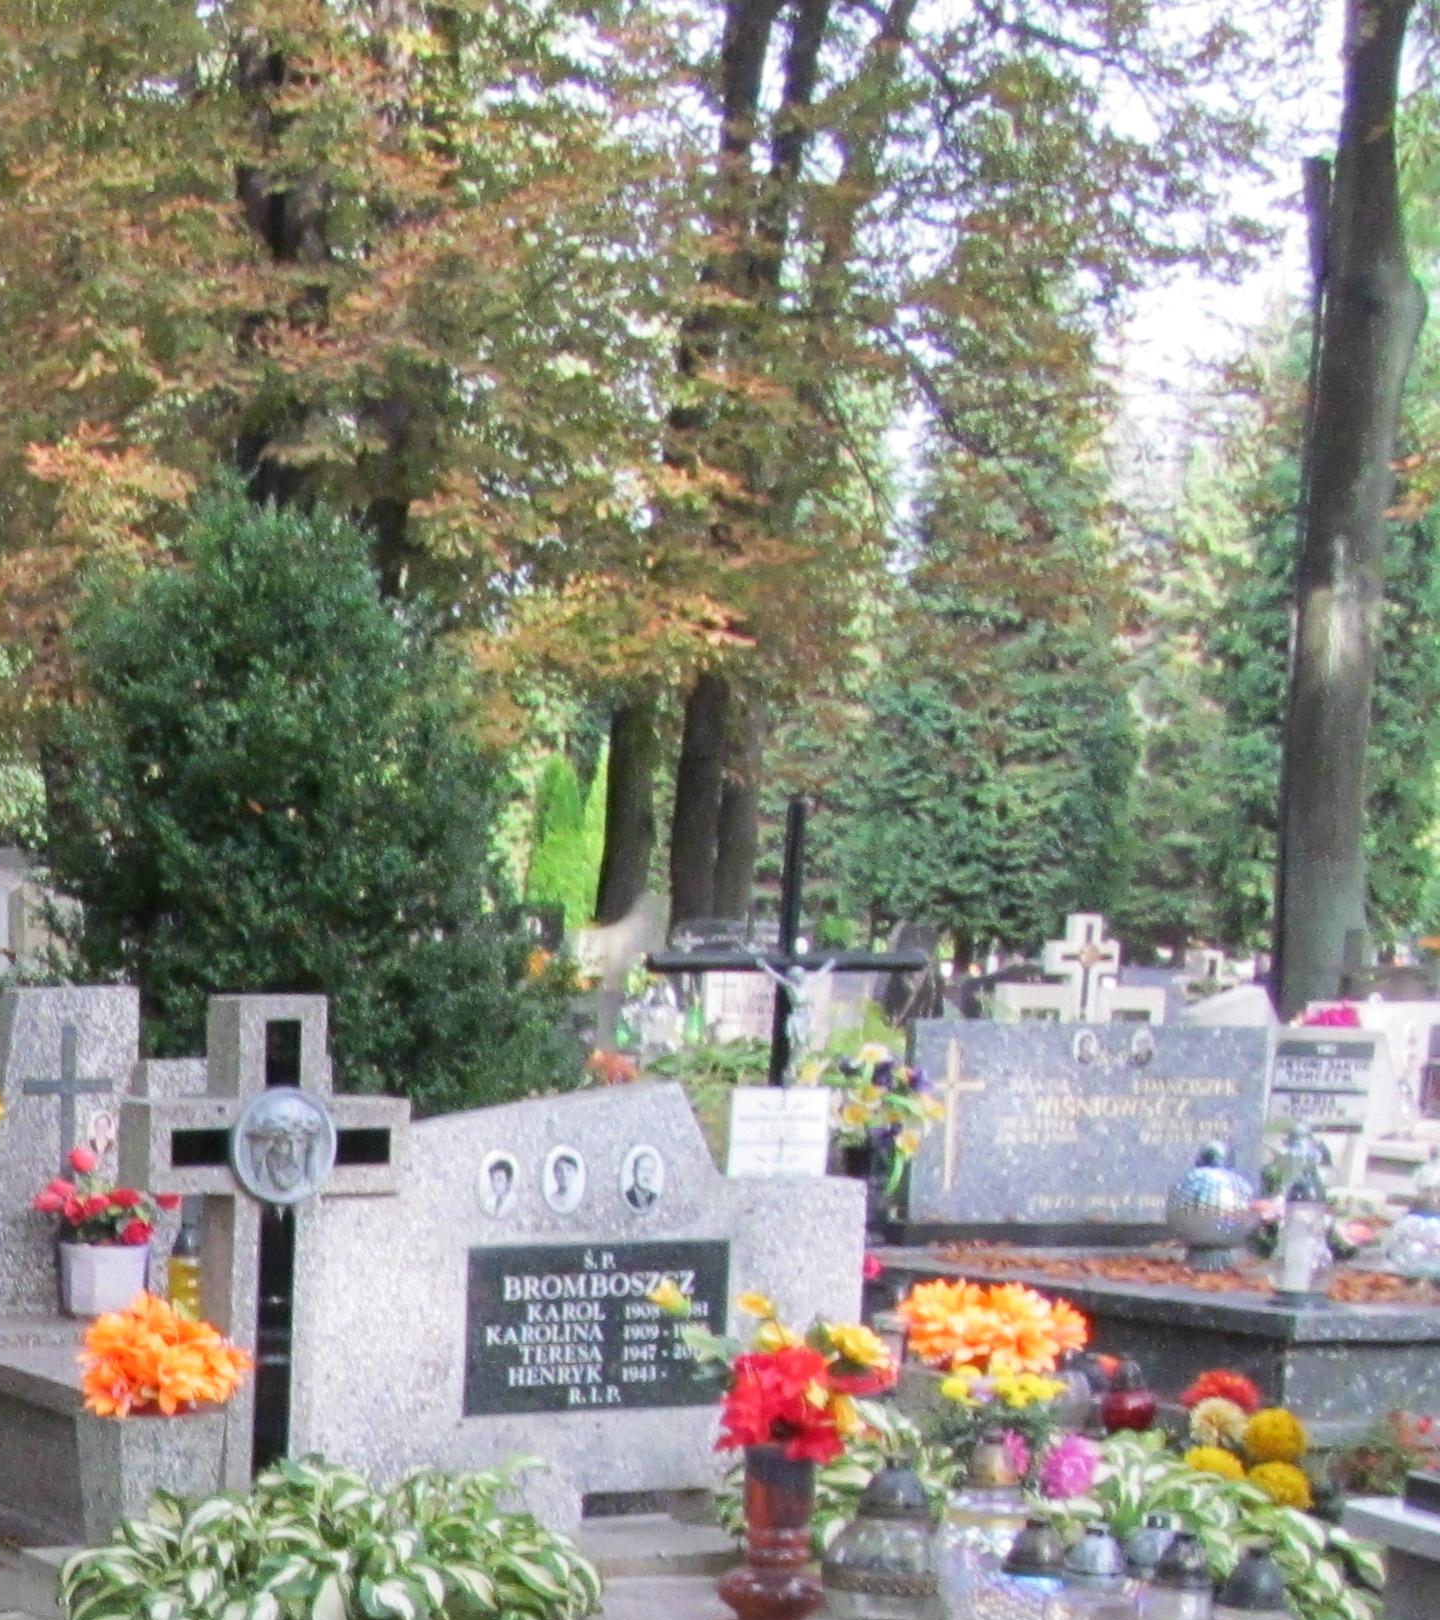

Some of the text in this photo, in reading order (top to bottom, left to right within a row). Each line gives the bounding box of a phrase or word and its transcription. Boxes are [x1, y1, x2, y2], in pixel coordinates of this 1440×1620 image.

[527, 1301, 606, 1323] KAROL
[485, 1323, 604, 1346] KAROLINA
[520, 1345, 604, 1366] TERESA
[507, 1364, 603, 1387] HENRYK
